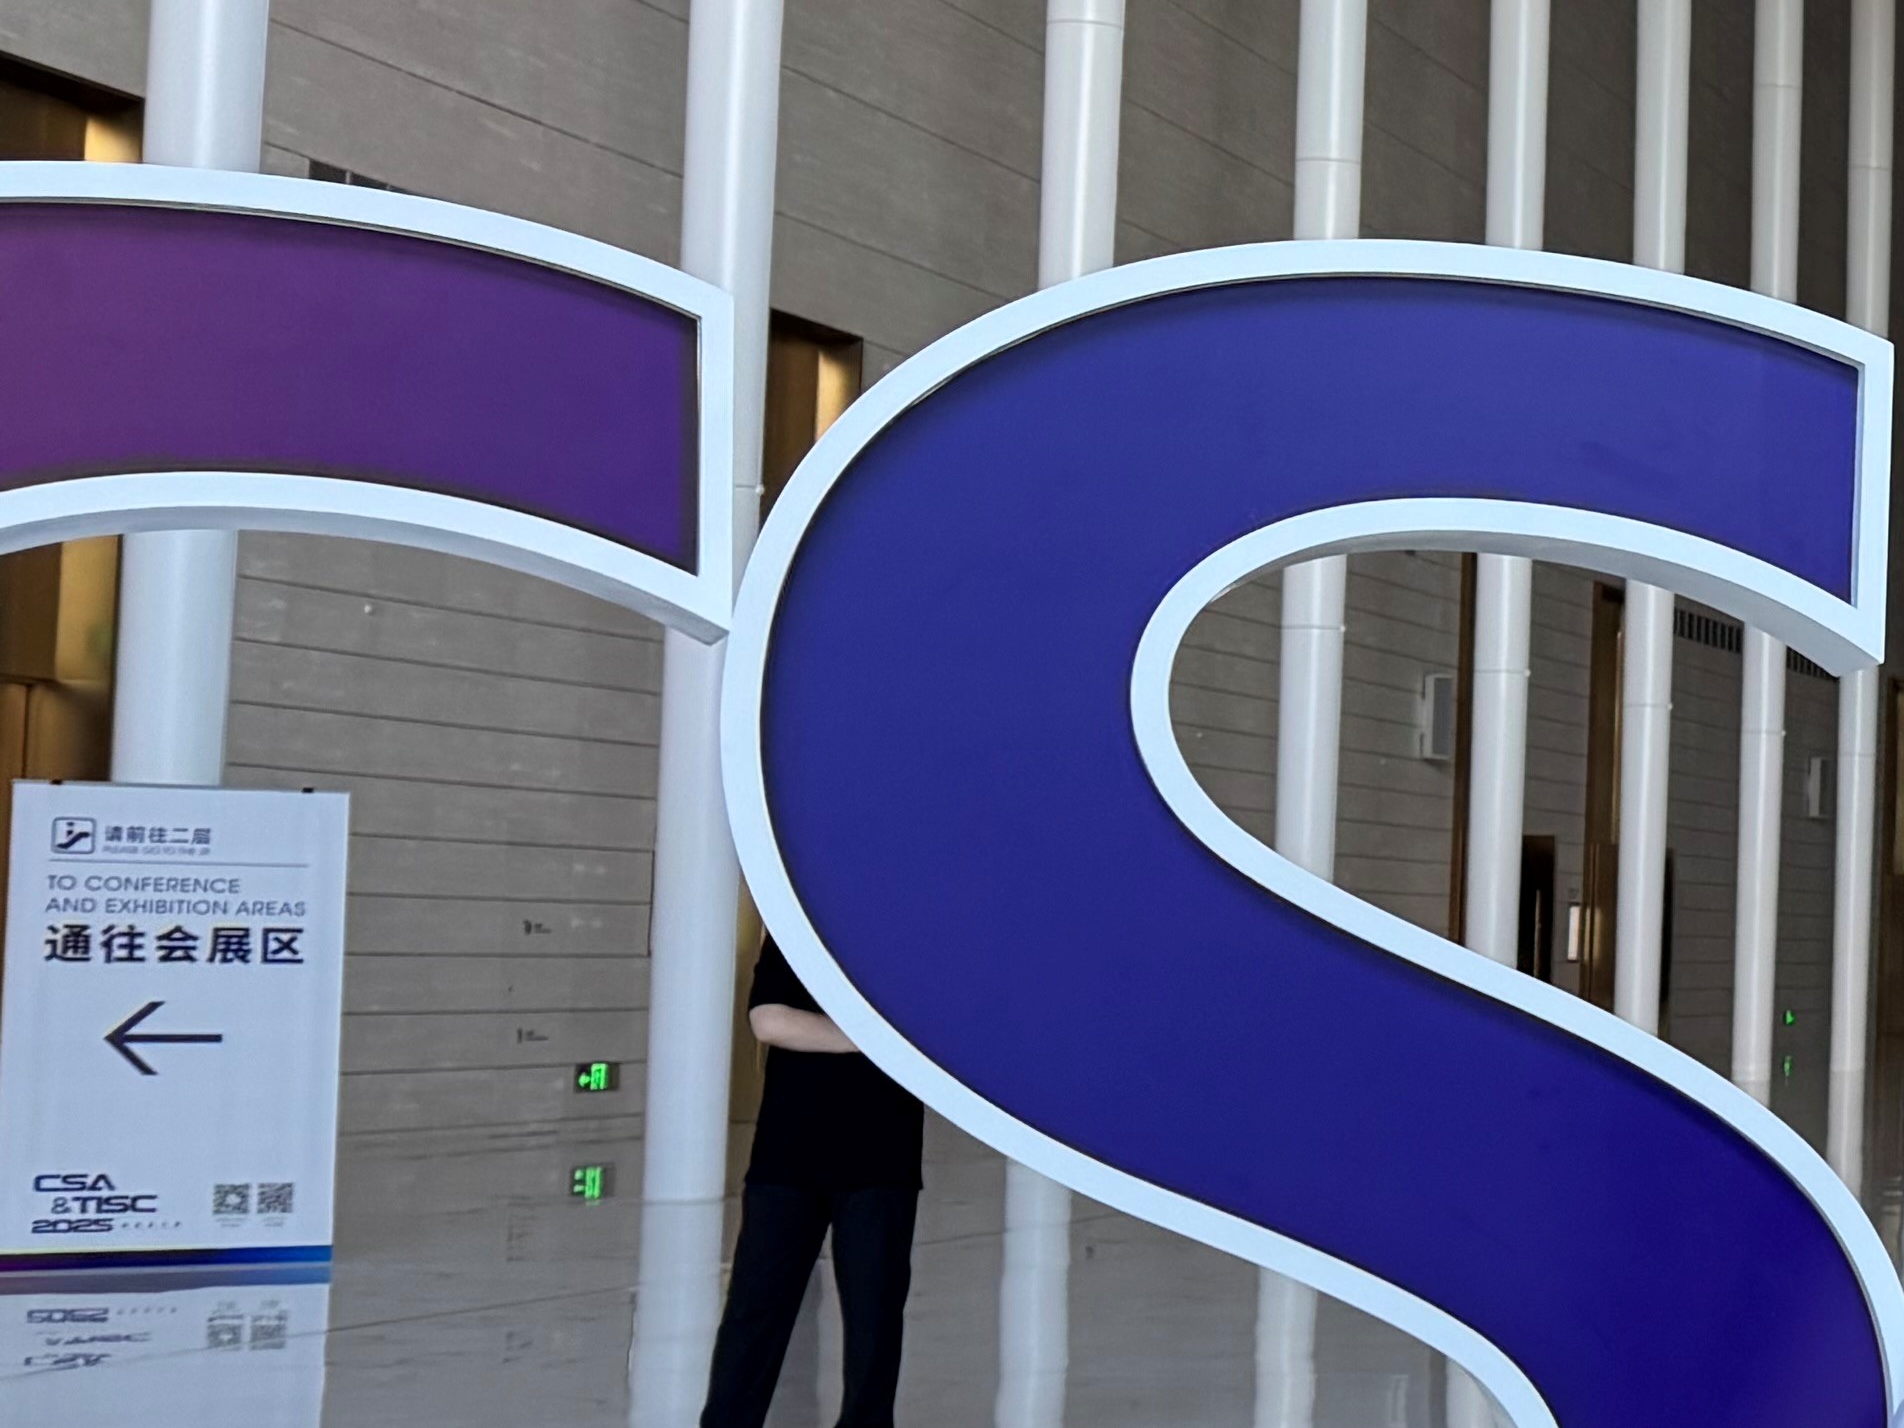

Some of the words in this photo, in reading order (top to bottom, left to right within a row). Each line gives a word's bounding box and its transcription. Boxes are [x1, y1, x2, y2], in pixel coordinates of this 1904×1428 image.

[47, 874, 77, 891] TO
[84, 875, 241, 894] CONFERENCE
[45, 897, 97, 914] AND
[104, 898, 229, 915] EXHIBITION
[235, 900, 306, 917] AREAS
[44, 923, 305, 965] 通往会展区
[33, 1173, 116, 1192] CSA
[31, 1218, 115, 1234] 2025
